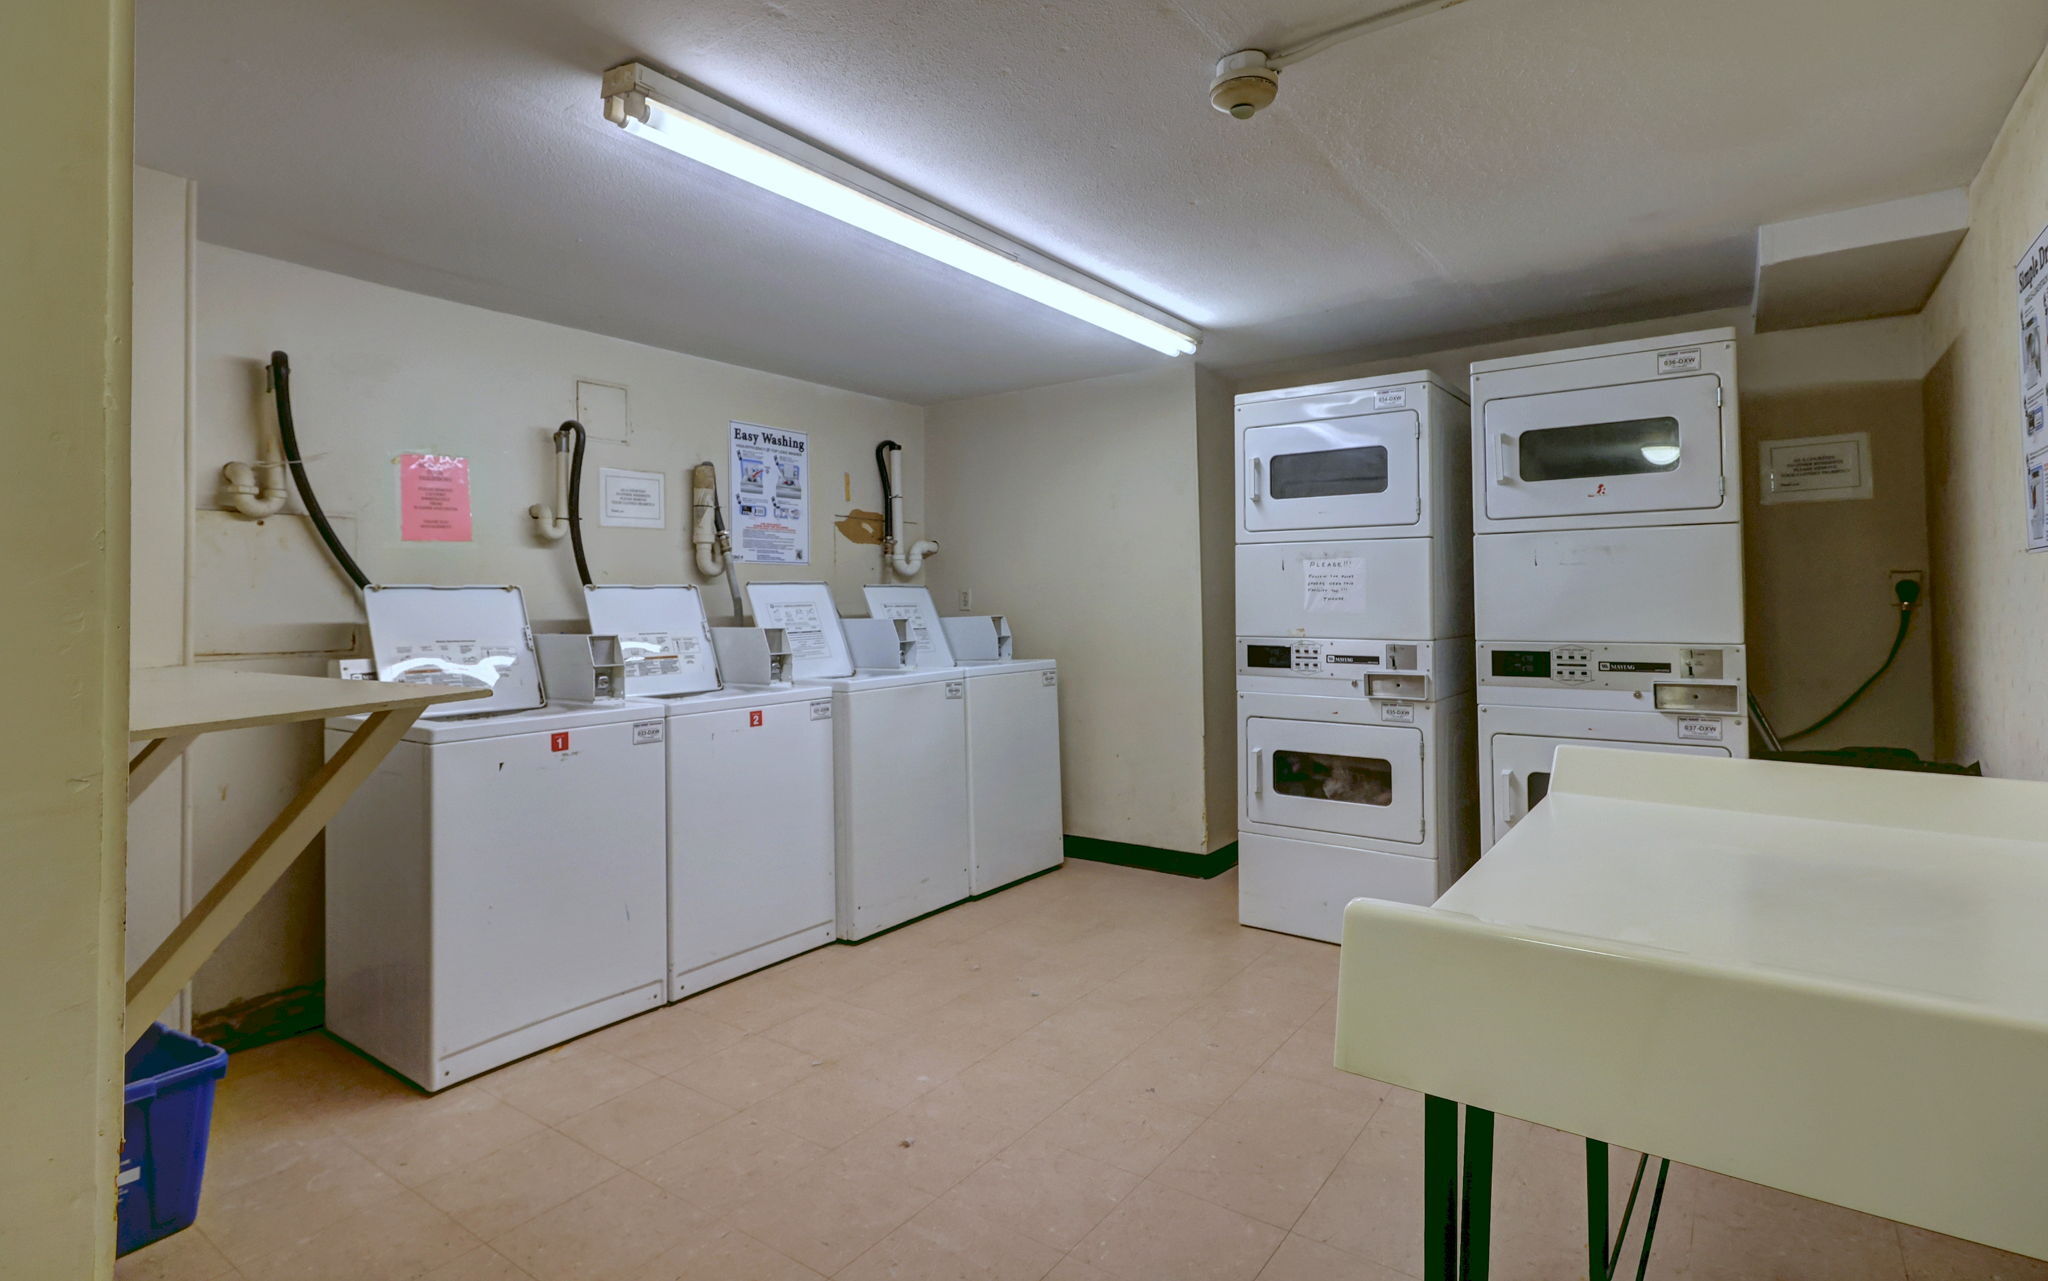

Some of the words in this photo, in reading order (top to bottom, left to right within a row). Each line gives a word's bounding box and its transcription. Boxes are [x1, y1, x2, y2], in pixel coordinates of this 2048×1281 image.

[2019, 255, 2039, 294] Simple
[734, 427, 759, 445] Easy
[761, 432, 805, 452] Washing
[753, 715, 760, 725] 2
[556, 737, 563, 749] 1
